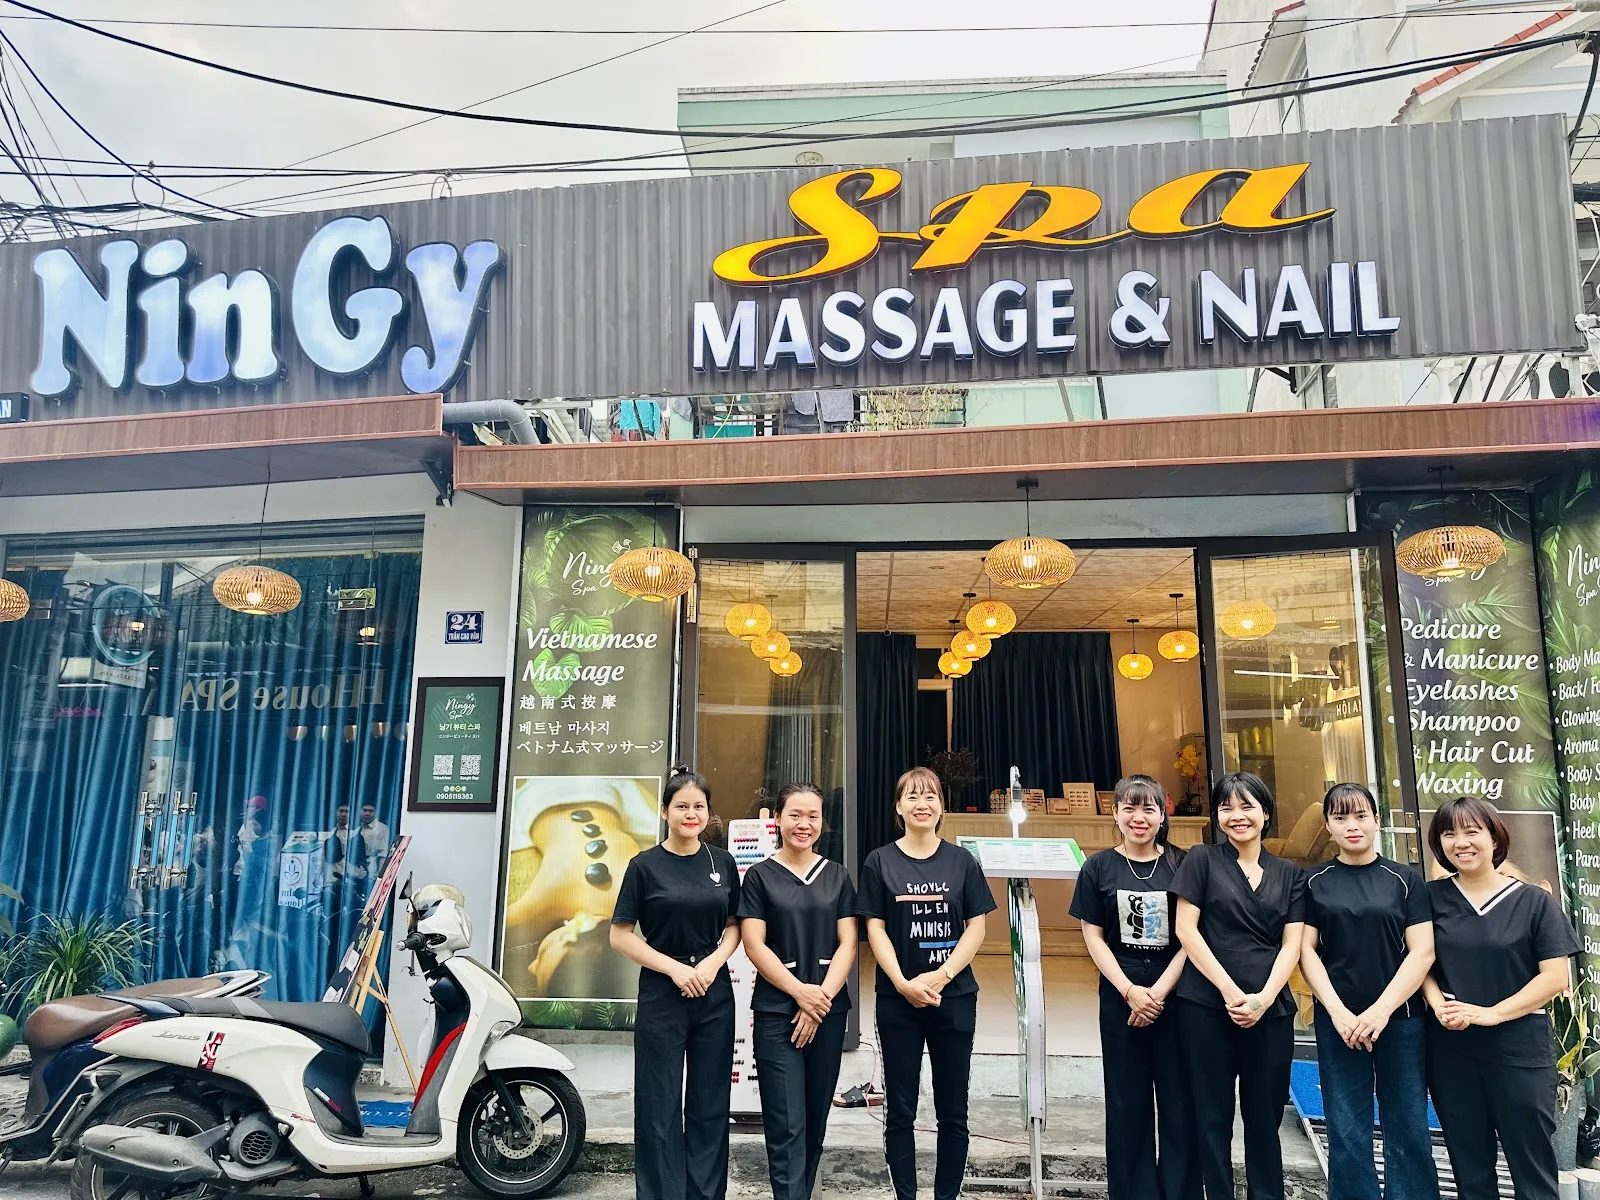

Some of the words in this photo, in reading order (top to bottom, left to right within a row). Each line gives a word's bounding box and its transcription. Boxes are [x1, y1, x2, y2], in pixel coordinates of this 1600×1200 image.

[712, 162, 1336, 284] Spa
[31, 217, 502, 395] NinGy
[692, 278, 1078, 372] MASSAGE
[1109, 270, 1171, 349] &
[1198, 261, 1401, 345] NAIL
[572, 579, 599, 596] Spa
[1576, 583, 1599, 607] Spa
[450, 614, 479, 631] 24
[1401, 617, 1502, 640] Pedicure
[526, 627, 658, 650] Vietnamese
[1420, 647, 1540, 671] Manicure
[1556, 653, 1581, 674] Body
[522, 660, 625, 687] Massage
[1407, 678, 1519, 706] Eyelashes
[1559, 677, 1589, 700] Back/
[445, 697, 476, 716] Ningy
[519, 694, 617, 711] 越南式按摩
[519, 720, 562, 736] 베트남
[567, 720, 610, 736] 마사지
[1409, 708, 1521, 737] Shampoo
[516, 740, 664, 755] ベトナム式マッサージ
[1428, 738, 1485, 764] Hair
[1490, 740, 1536, 764] Cut
[1563, 737, 1600, 756] Aroma
[1416, 771, 1504, 800] Waxing
[1567, 764, 1593, 786] Body
[1569, 792, 1596, 815] Body
[1572, 819, 1596, 840] Heel
[1575, 849, 1600, 871] Para
[151, 1029, 202, 1041] Janus
